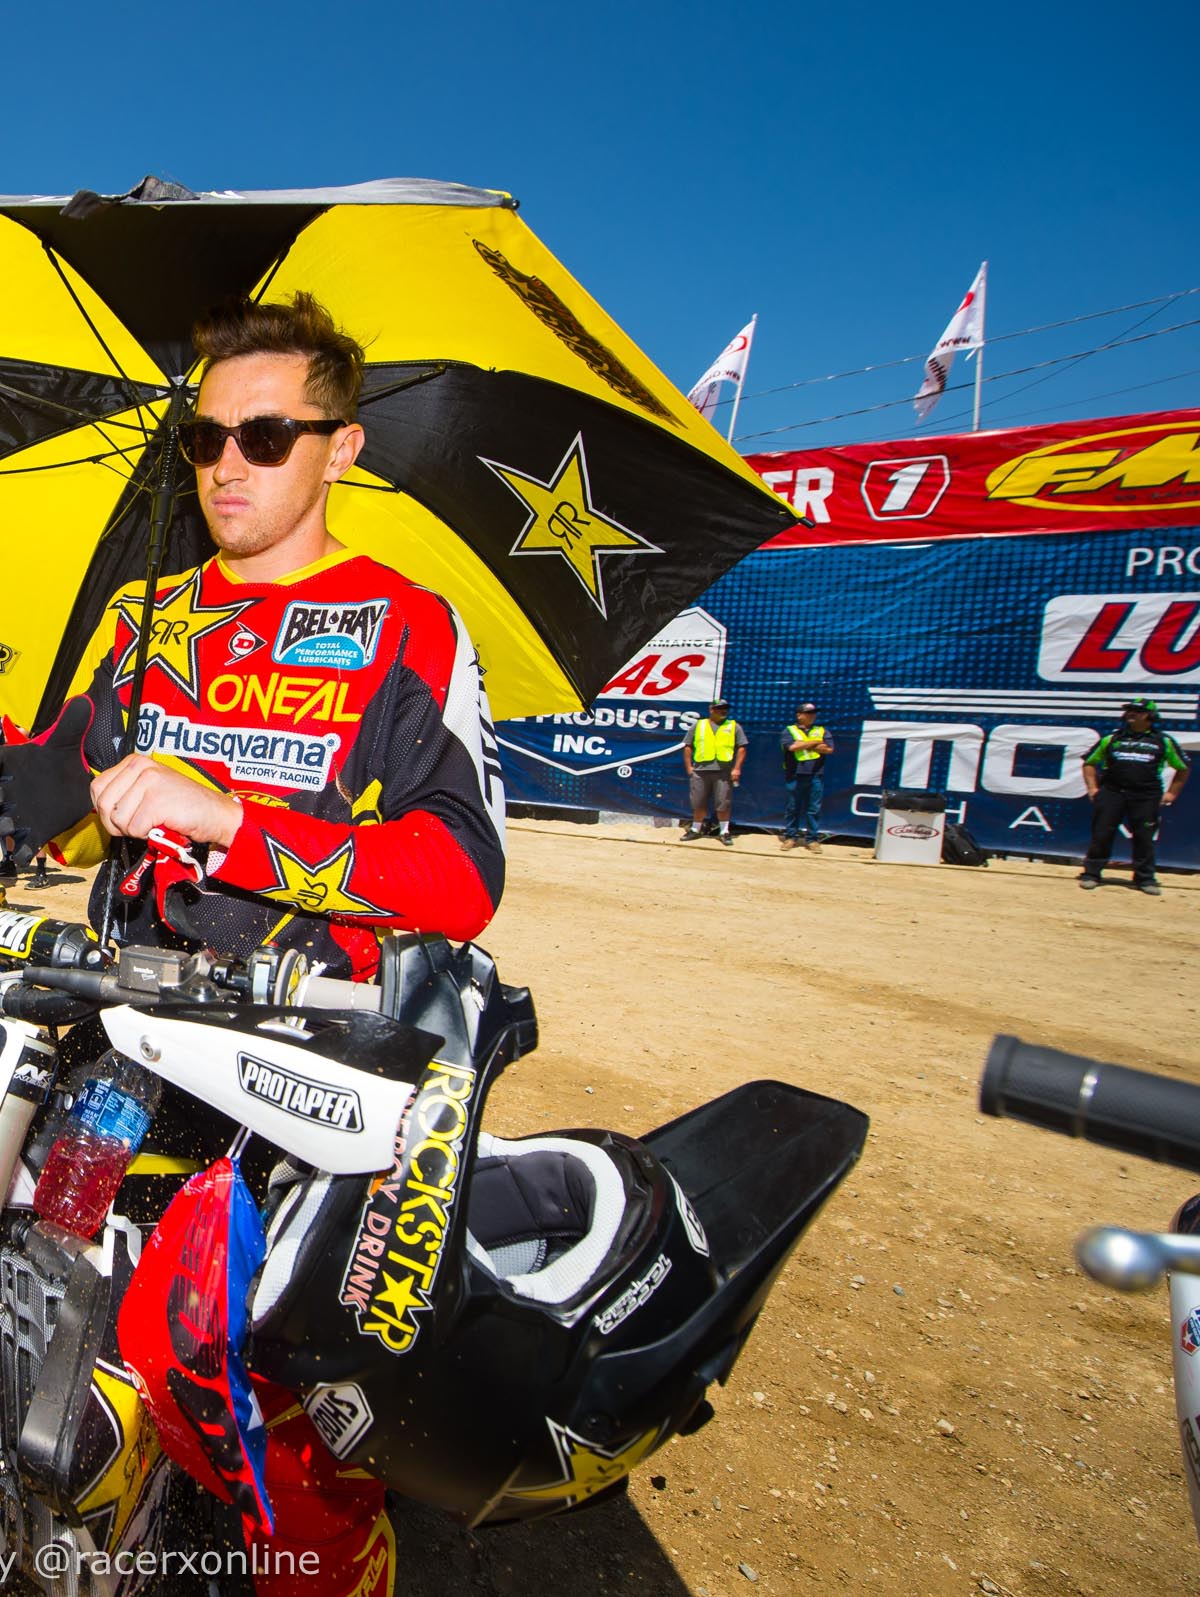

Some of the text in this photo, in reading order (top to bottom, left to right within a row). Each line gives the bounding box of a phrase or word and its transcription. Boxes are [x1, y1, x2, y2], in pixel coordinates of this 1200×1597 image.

[881, 463, 930, 512] 1
[295, 648, 358, 658] PERFORMANCE
[298, 656, 351, 666] LUBRICANTS
[159, 721, 327, 767] Husqvarna
[553, 735, 612, 756] INC.
[235, 766, 320, 785] FACTORY RACING
[243, 1061, 354, 1128] PROTAPER
[344, 1210, 392, 1311] DRINK
